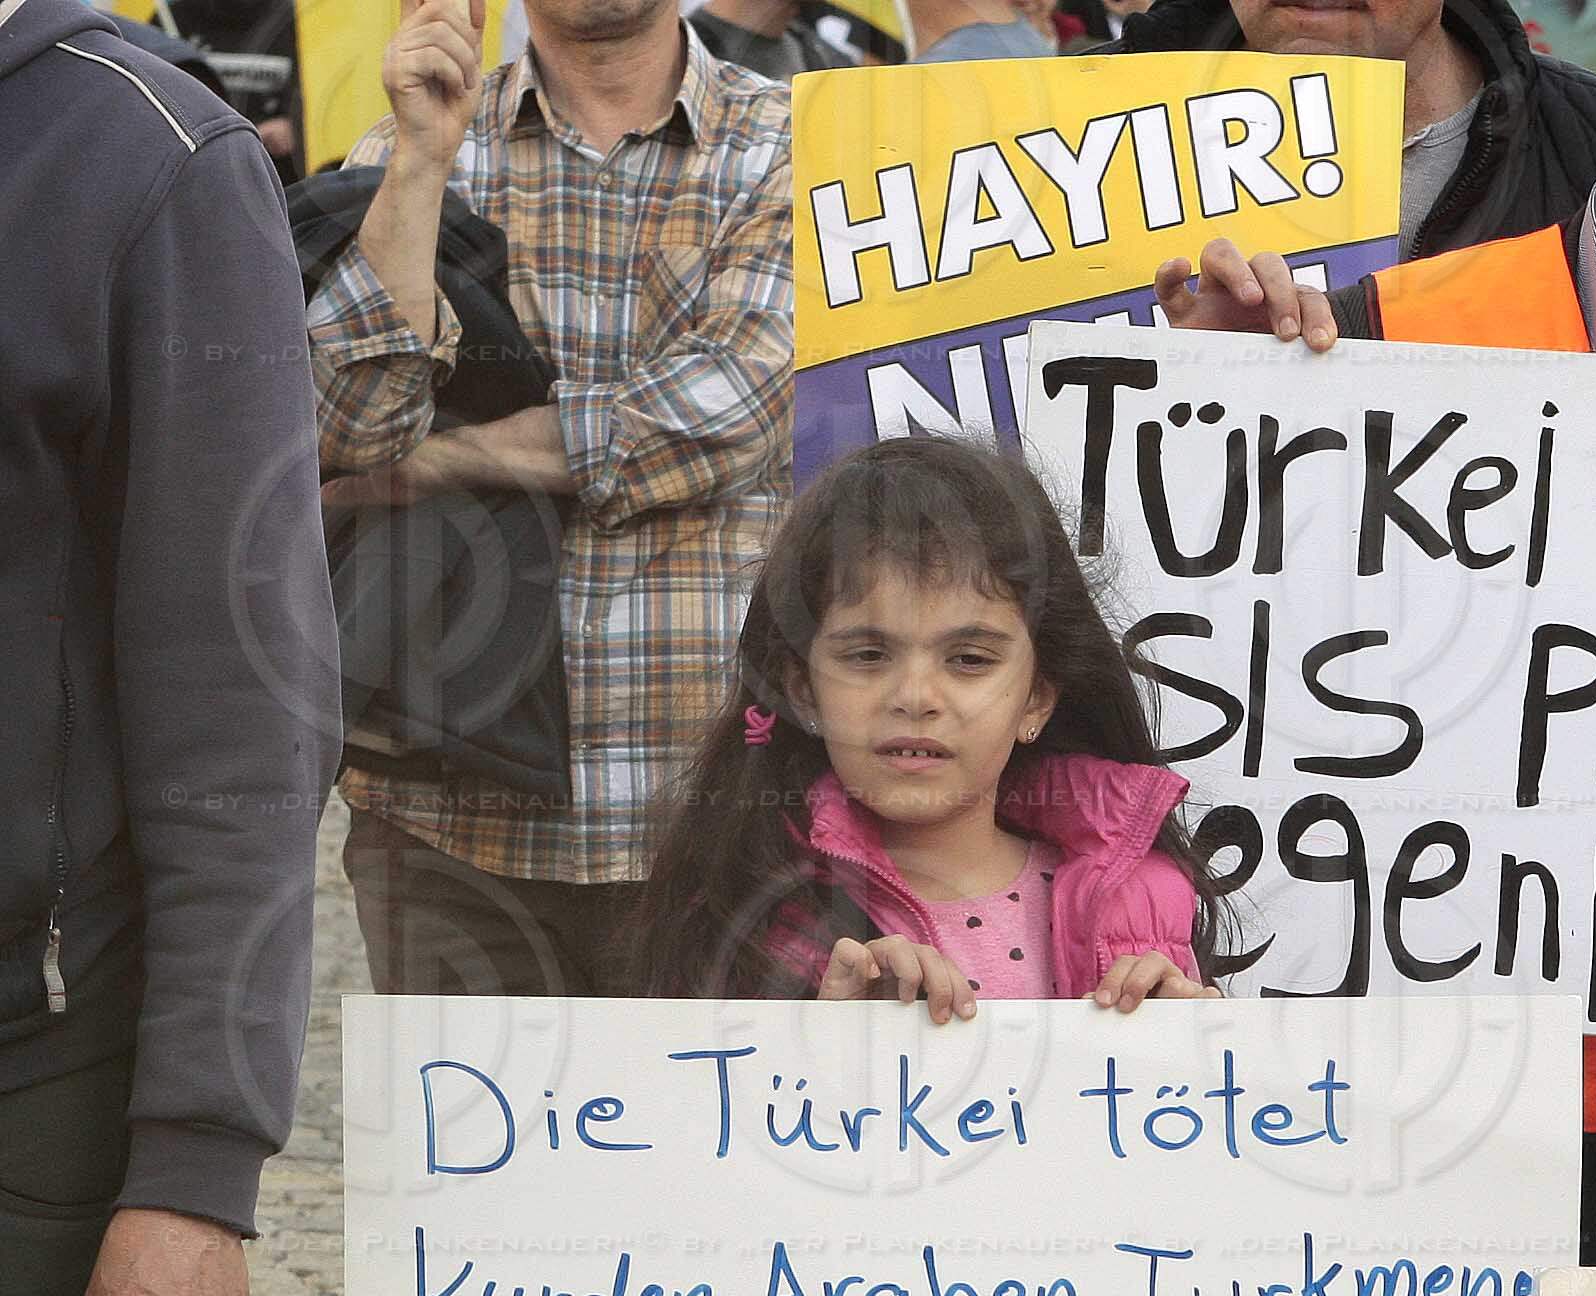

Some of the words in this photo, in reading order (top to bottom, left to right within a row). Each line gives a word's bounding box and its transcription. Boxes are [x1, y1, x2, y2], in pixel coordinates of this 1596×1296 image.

[810, 72, 1344, 309] HAYIR!
[1121, 600, 1425, 778] SIS
[1192, 793, 1561, 999] egen
[421, 1061, 652, 1175] Die
[670, 1046, 1026, 1159] Türkei
[1080, 1050, 1351, 1159] tötet
